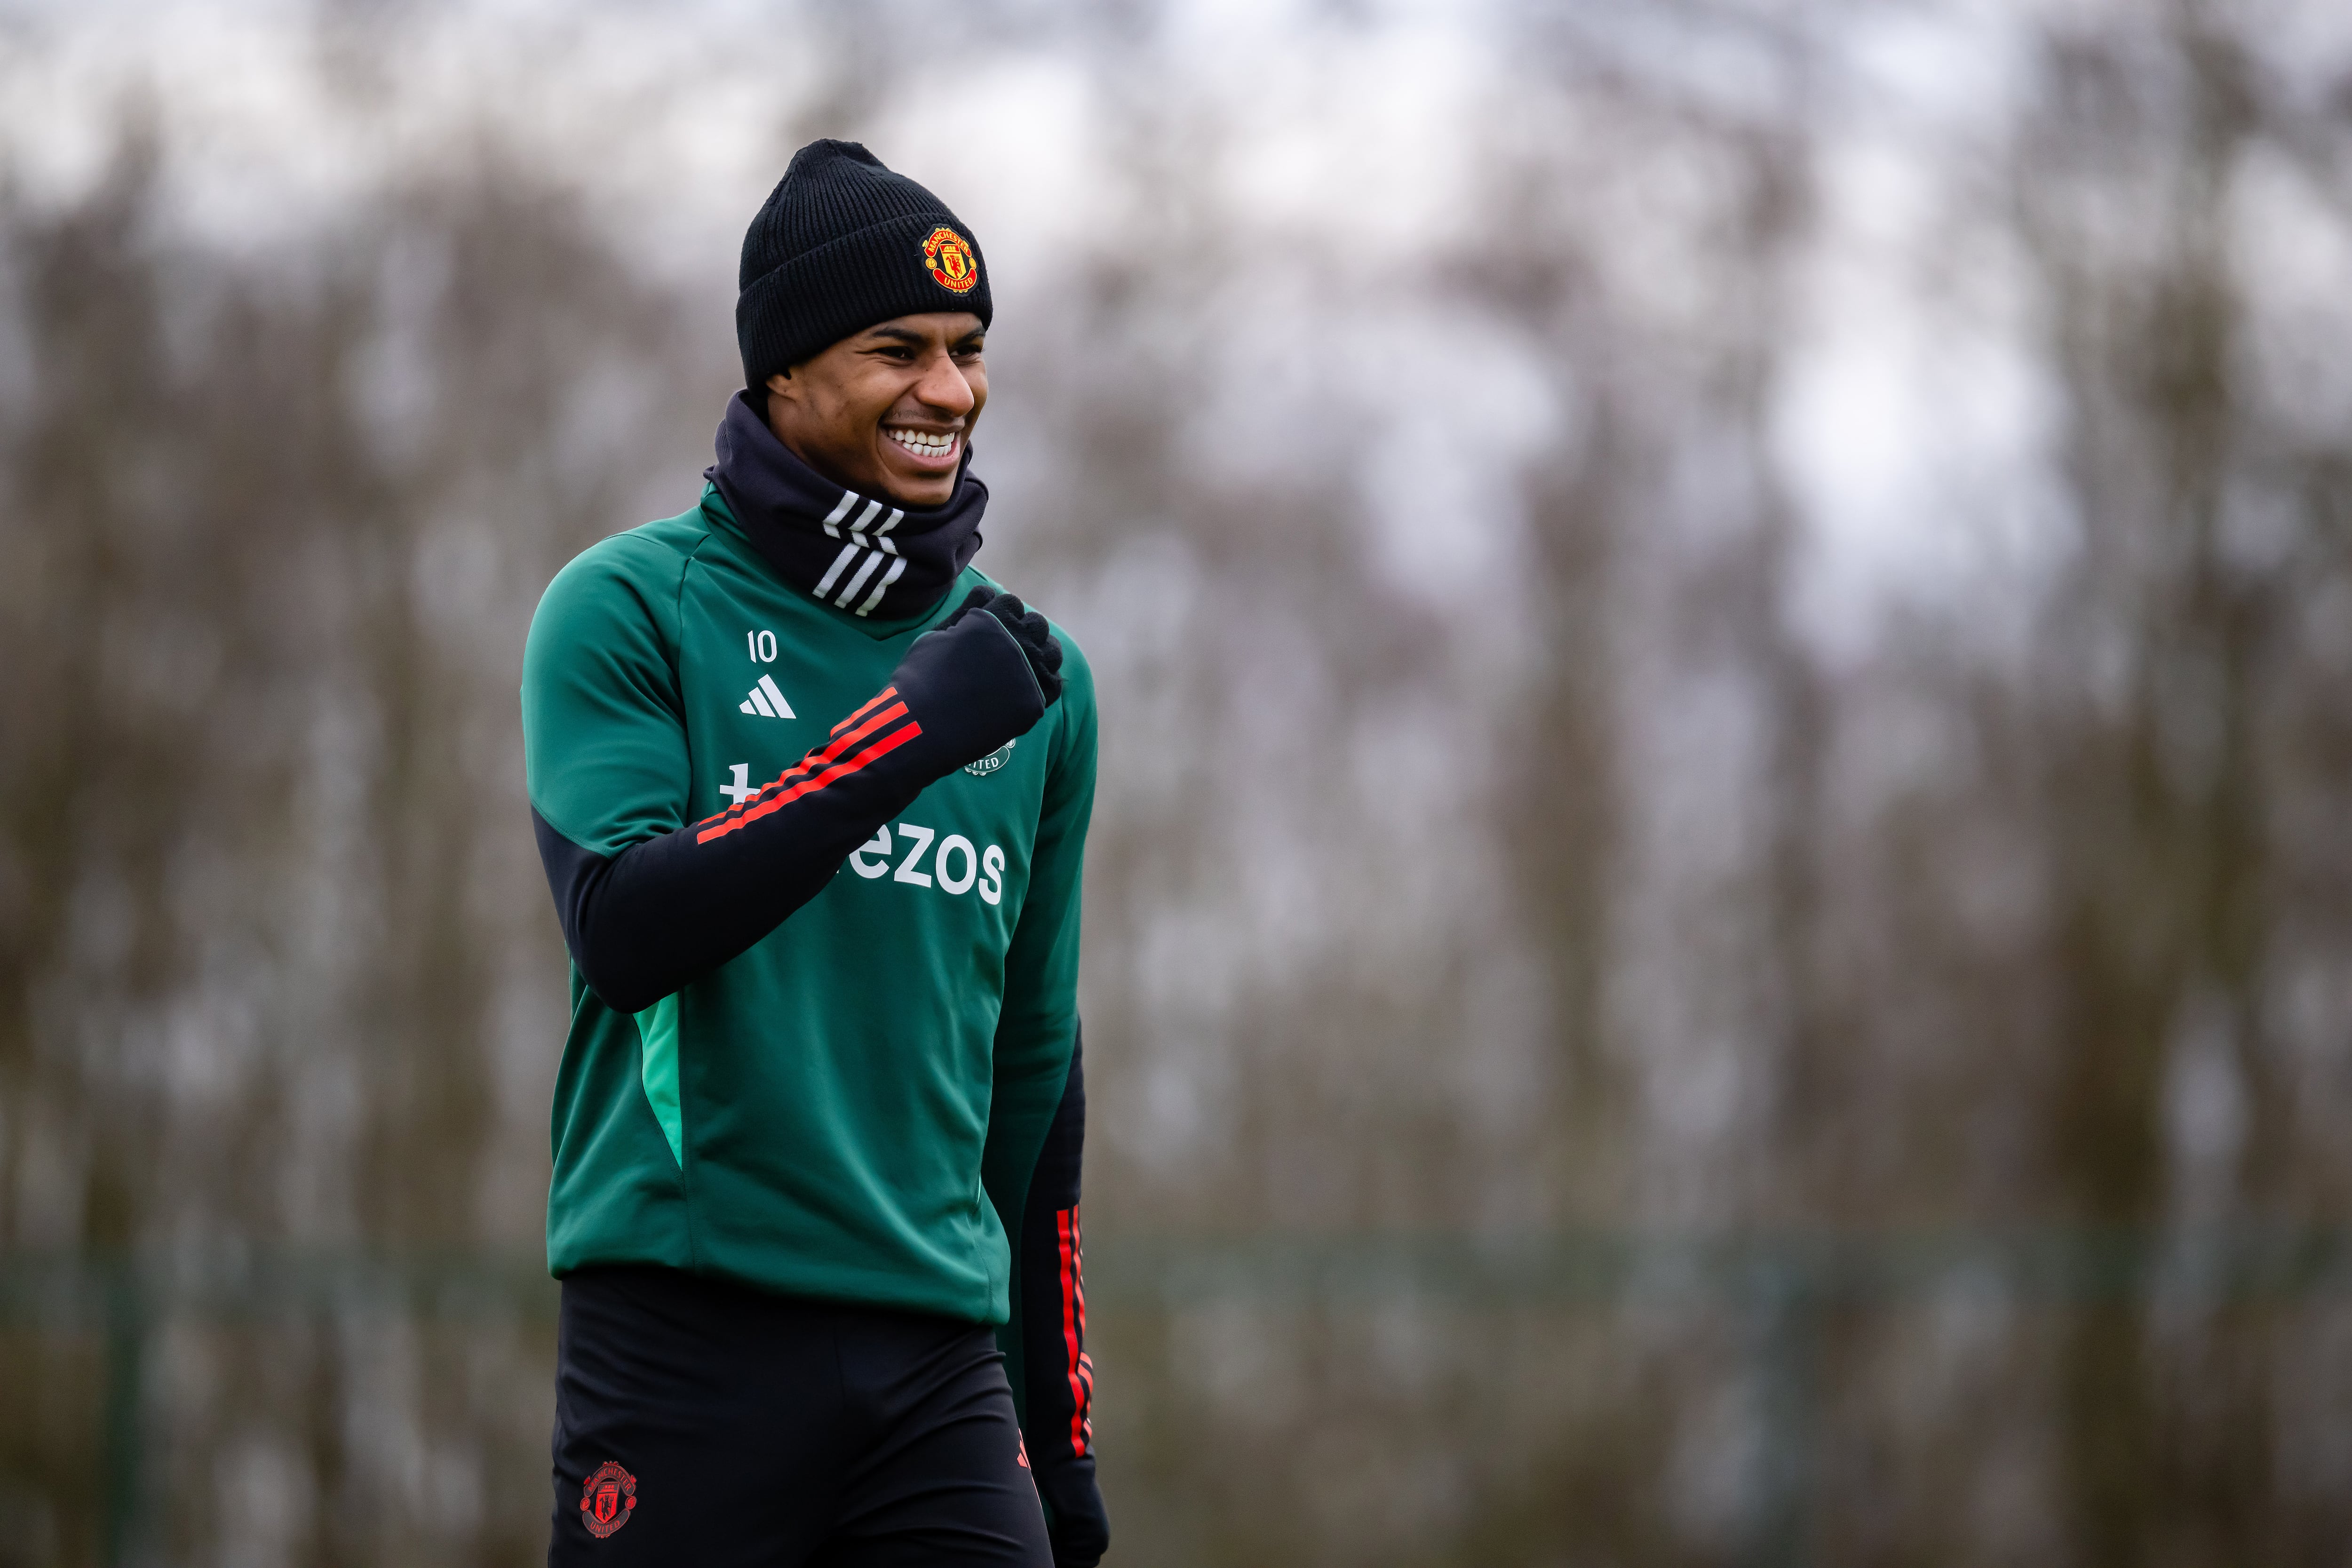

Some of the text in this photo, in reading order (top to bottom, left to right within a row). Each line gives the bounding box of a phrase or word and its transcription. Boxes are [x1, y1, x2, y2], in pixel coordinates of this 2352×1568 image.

[928, 232, 969, 253] MANCHESTER
[944, 277, 973, 288] UNITED
[747, 630, 777, 663] 10
[969, 757, 999, 769] ITED
[836, 824, 1005, 905] ezos
[588, 1468, 631, 1492] MANCHESTER
[590, 1520, 620, 1533] UNITED
